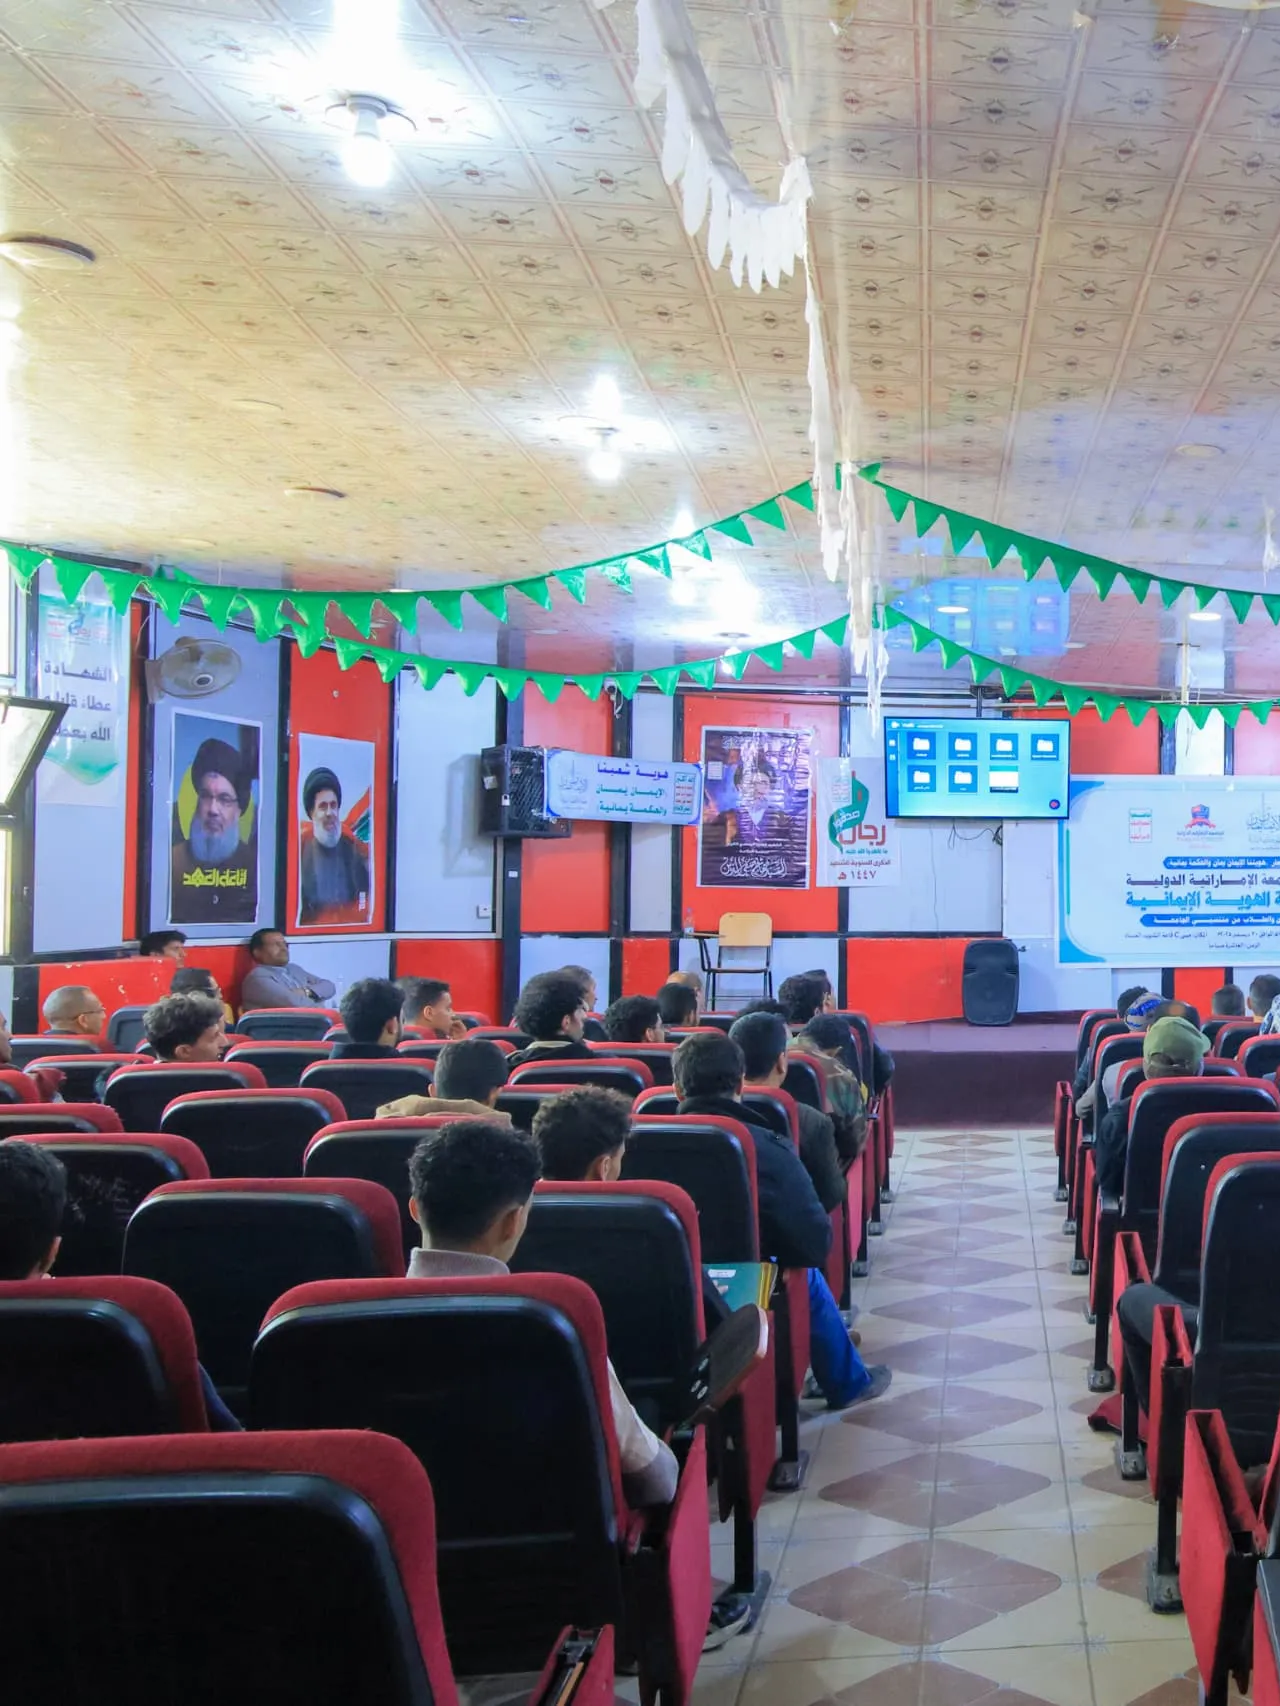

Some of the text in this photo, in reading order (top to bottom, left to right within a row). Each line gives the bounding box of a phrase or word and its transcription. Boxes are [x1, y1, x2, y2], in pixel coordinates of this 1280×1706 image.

[44, 660, 112, 682] الشهادة
[81, 694, 112, 712] عطاء
[90, 721, 111, 741] الله
[597, 762, 669, 781] هوية شعبنا
[839, 821, 886, 847] رجال
[851, 869, 877, 880] ١٤٤٧
[1126, 873, 1185, 889] الدولية
[1189, 872, 1258, 889] الإماراتية
[1126, 890, 1200, 912] الإيمانية
[1204, 890, 1270, 910] الهوية
